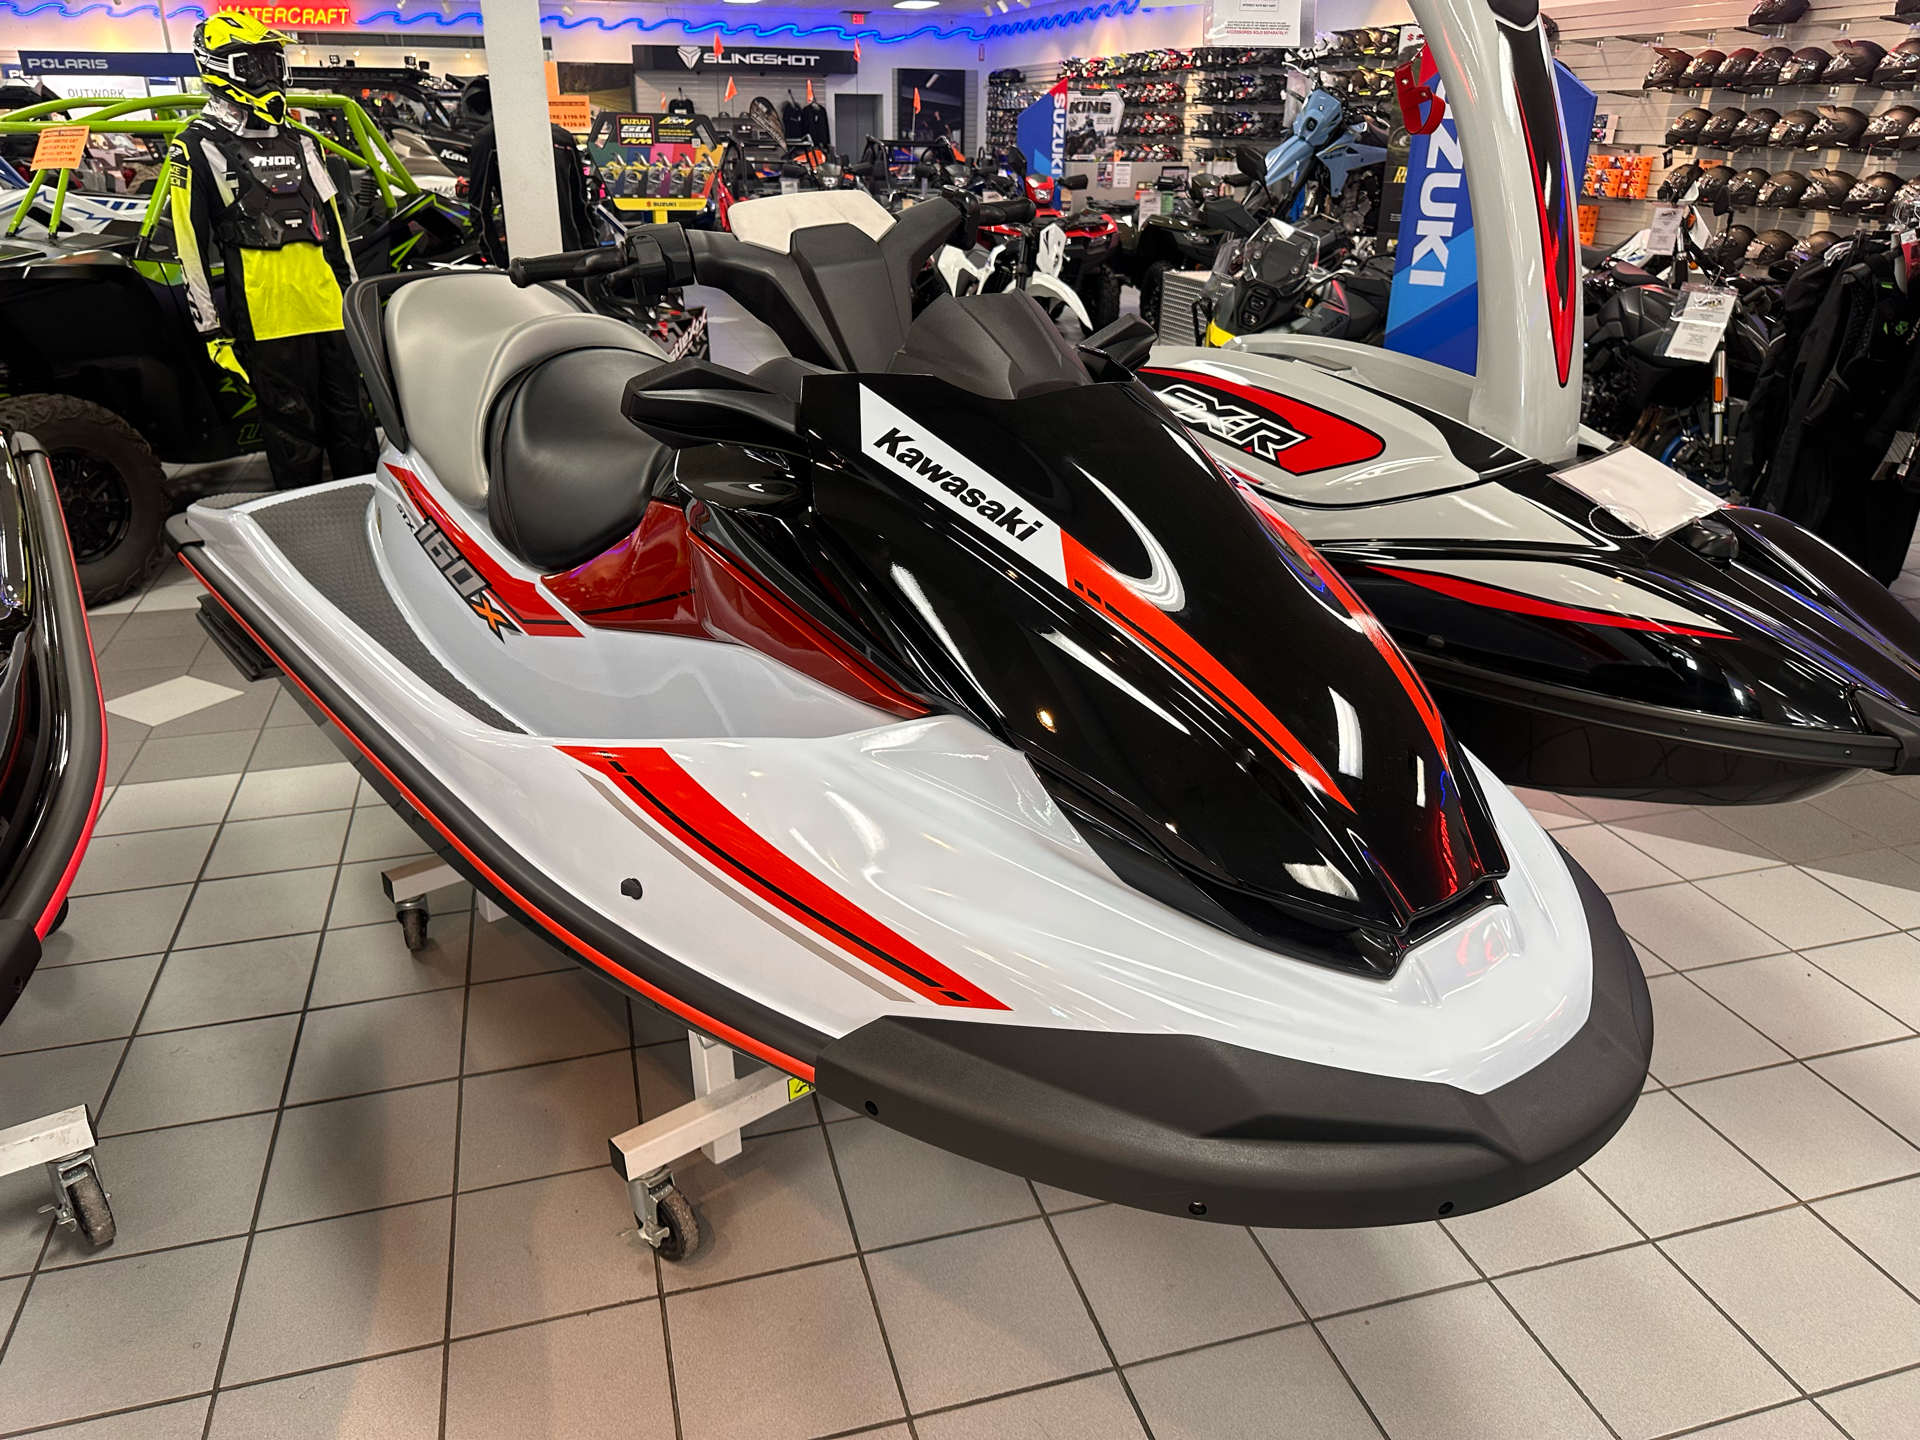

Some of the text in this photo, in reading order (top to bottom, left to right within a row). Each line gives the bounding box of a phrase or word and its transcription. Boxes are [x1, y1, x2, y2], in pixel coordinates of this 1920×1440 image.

[27, 58, 109, 70] POLARIS
[703, 52, 820, 66] SLINGSHOT
[67, 88, 125, 99] OUTWORK
[1068, 101, 1112, 115] KING
[1050, 92, 1067, 175] SUZUKI
[249, 156, 296, 168] THOR
[1408, 79, 1465, 287] ZUKI
[873, 427, 1044, 542] Kawasaki
